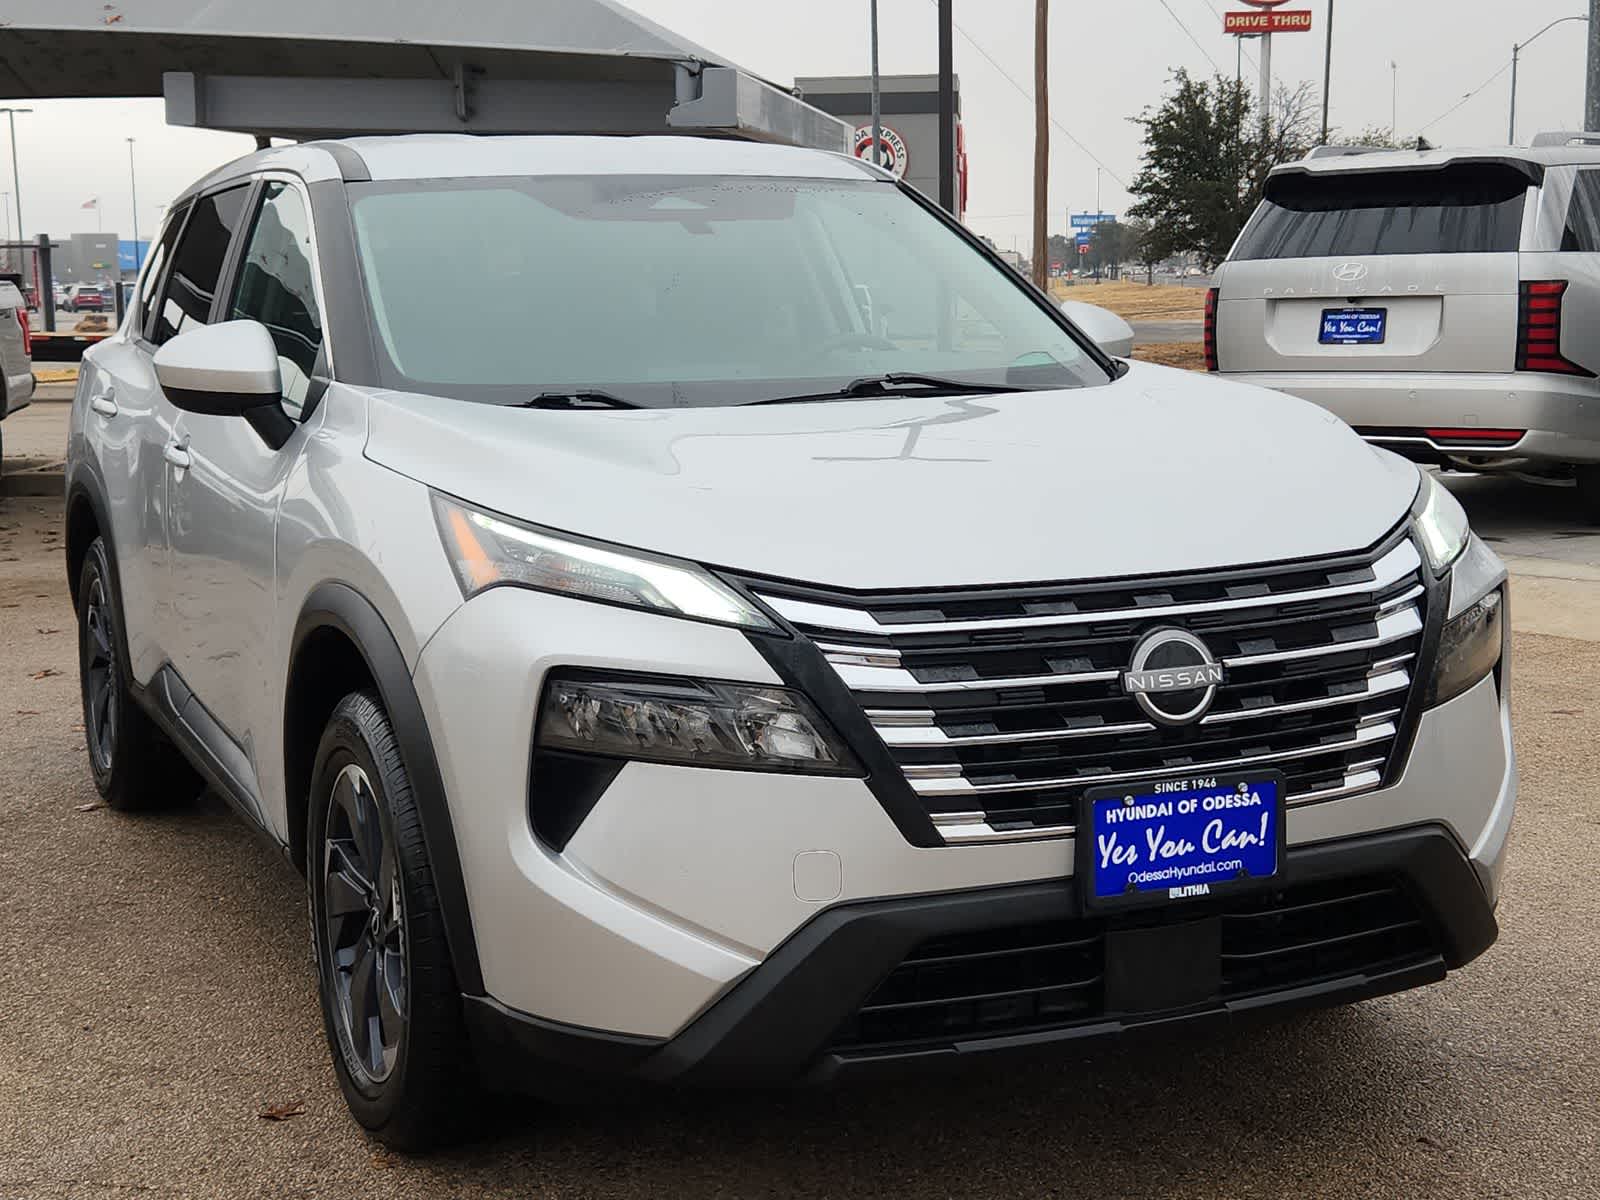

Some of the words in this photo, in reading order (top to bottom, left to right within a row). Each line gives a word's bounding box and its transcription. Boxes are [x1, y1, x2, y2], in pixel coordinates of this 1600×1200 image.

[1226, 15, 1268, 27] DRIVE
[1272, 14, 1311, 26] THRU
[879, 127, 905, 160] XPRESS
[1323, 321, 1336, 334] Yes
[1339, 320, 1355, 333] You
[1357, 320, 1382, 333] Can!
[1128, 666, 1222, 690] NISSAN
[1154, 781, 1188, 794] SINCE
[1191, 777, 1217, 790] 1946
[1106, 802, 1173, 824] HYUNDAI
[1177, 798, 1198, 815] OF
[1202, 791, 1262, 811] ODESSA
[1098, 831, 1138, 869] Yes
[1145, 824, 1196, 862] You
[1201, 811, 1269, 854] Can!
[1127, 858, 1243, 885] OdessaHyundai.com
[1178, 883, 1211, 898] LITHIA
